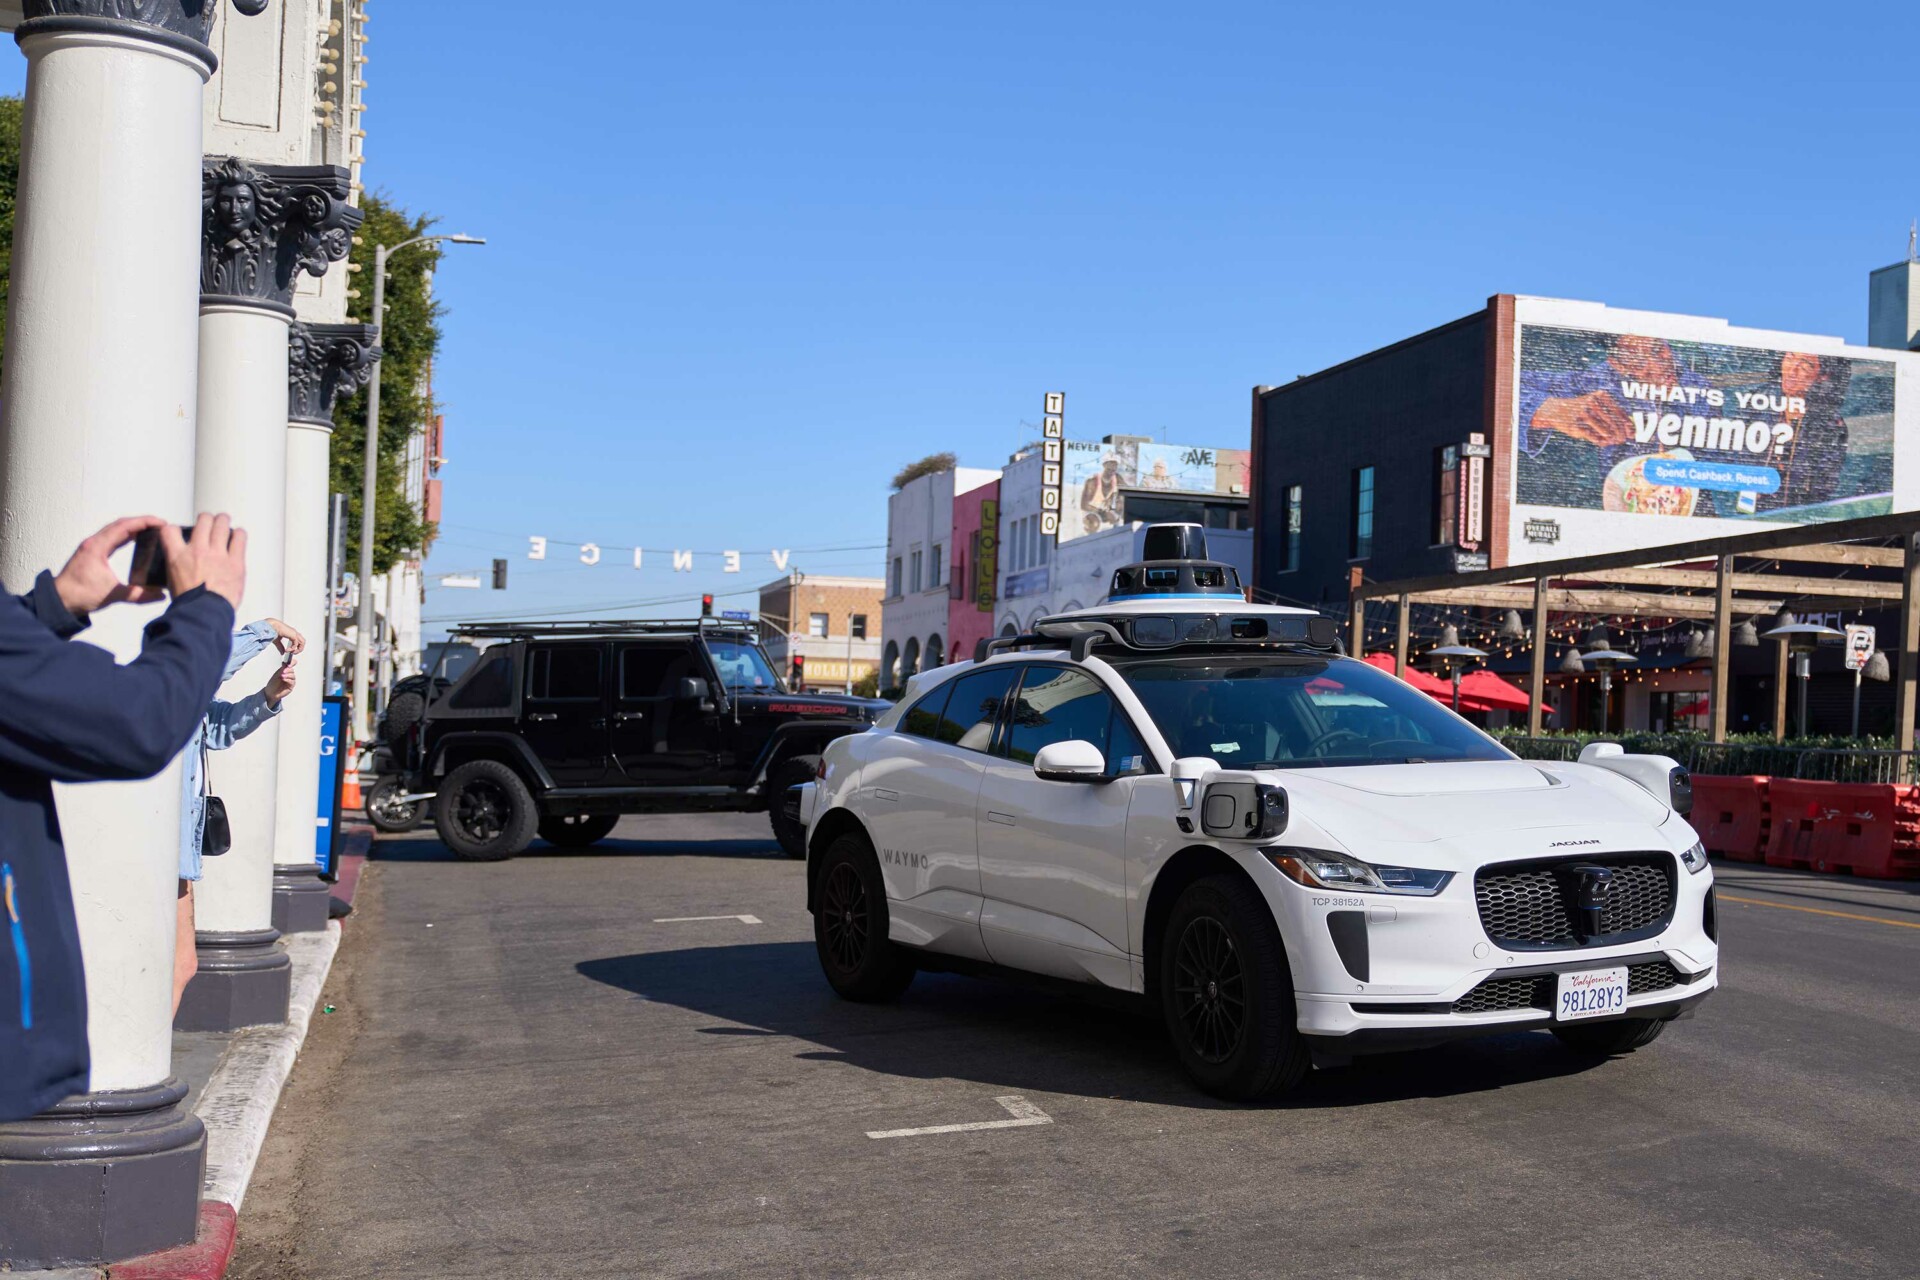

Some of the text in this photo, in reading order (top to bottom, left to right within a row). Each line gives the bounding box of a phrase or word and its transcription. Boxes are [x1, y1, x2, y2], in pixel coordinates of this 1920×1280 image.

[1621, 381, 1806, 414] WHAT'S YOUR
[1632, 411, 1794, 455] venmo?
[1067, 442, 1100, 453] NEVER
[1044, 396, 1060, 531] TATTOO
[1656, 466, 1770, 485] Spend. Cashback. Repeat.
[1549, 839, 1601, 848] JAGUAR
[883, 848, 928, 869] WAYMO
[1312, 898, 1365, 907] TCP 38152A
[1573, 974, 1616, 989] California
[1562, 986, 1623, 1013] 98128Y3
